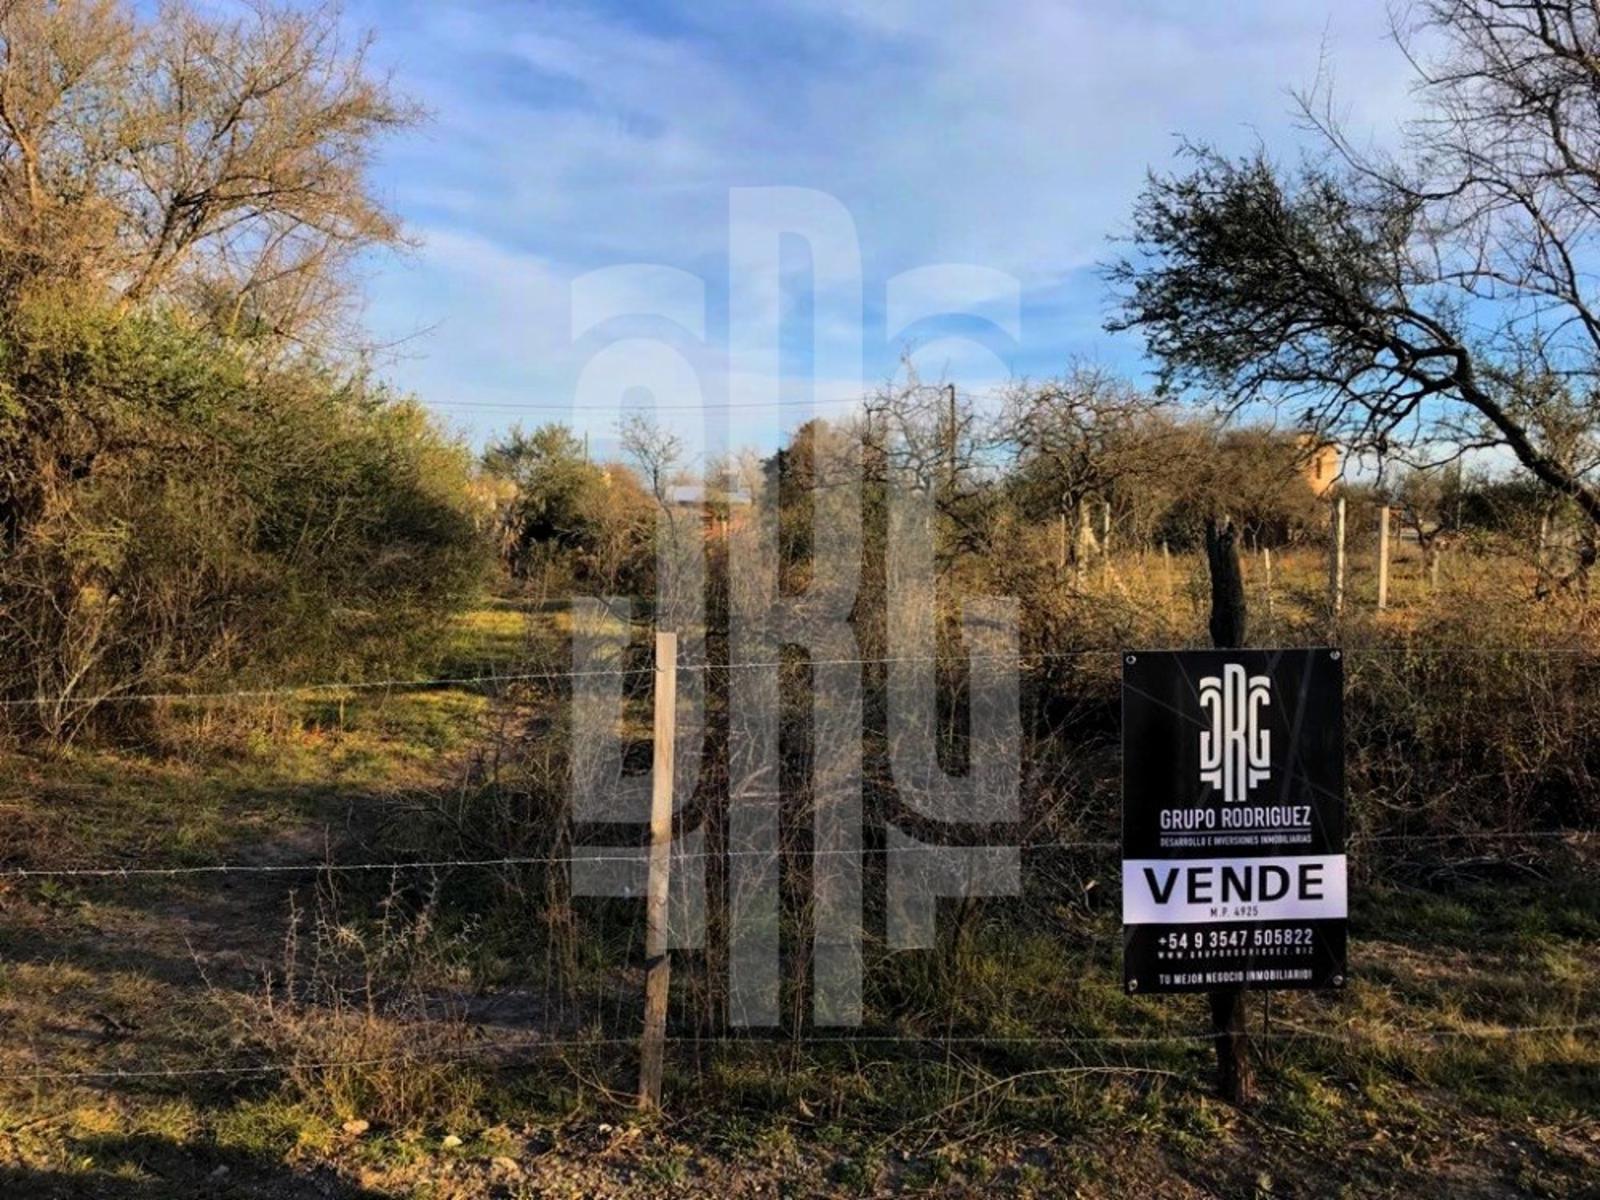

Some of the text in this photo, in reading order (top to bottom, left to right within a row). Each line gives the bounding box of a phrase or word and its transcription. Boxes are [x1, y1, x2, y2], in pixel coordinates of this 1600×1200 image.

[1160, 805, 1312, 830] GRUPO RODRIGUEZ
[1142, 863, 1324, 905] VENDE
[1233, 905, 1259, 917] 4925
[1157, 928, 1313, 950] +54 9 3547 505822
[1173, 972, 1203, 985] MEJOR
